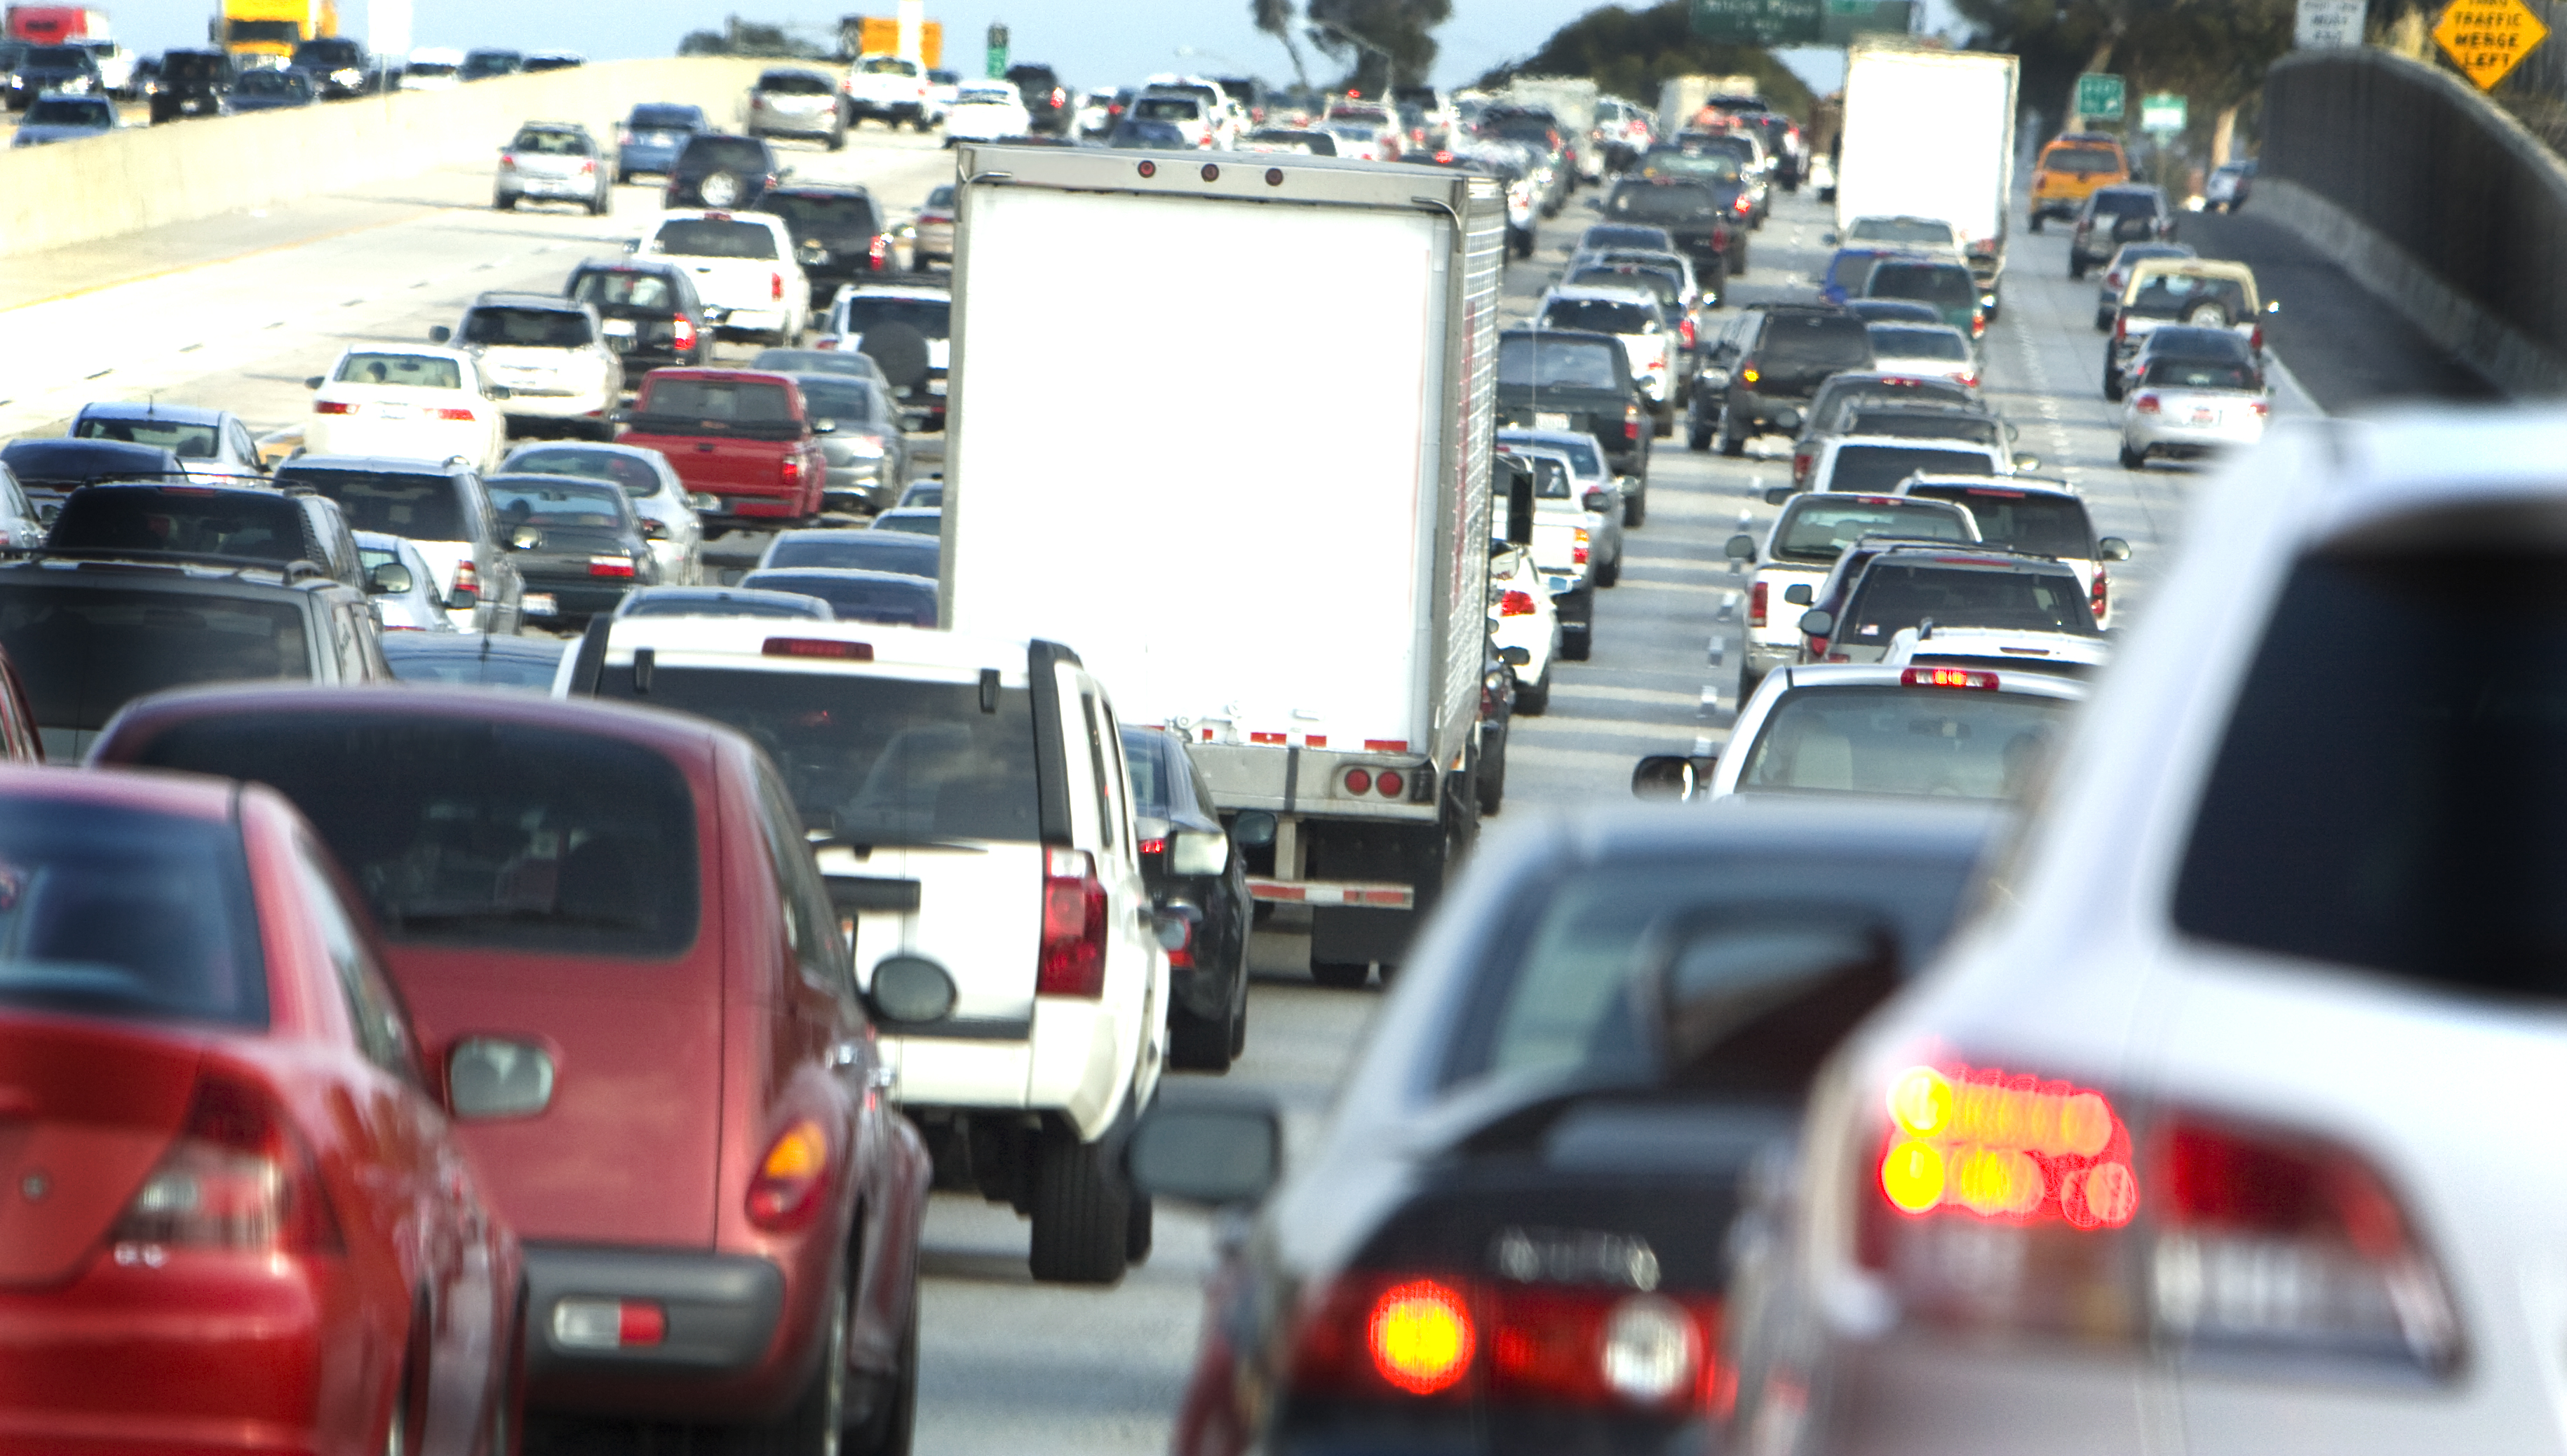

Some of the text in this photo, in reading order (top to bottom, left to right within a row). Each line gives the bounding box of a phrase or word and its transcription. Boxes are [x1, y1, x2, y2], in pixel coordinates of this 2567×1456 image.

[2455, 11, 2521, 26] TRAFFIC
[2455, 33, 2519, 48] MERGE
[2465, 53, 2510, 67] LEFT
